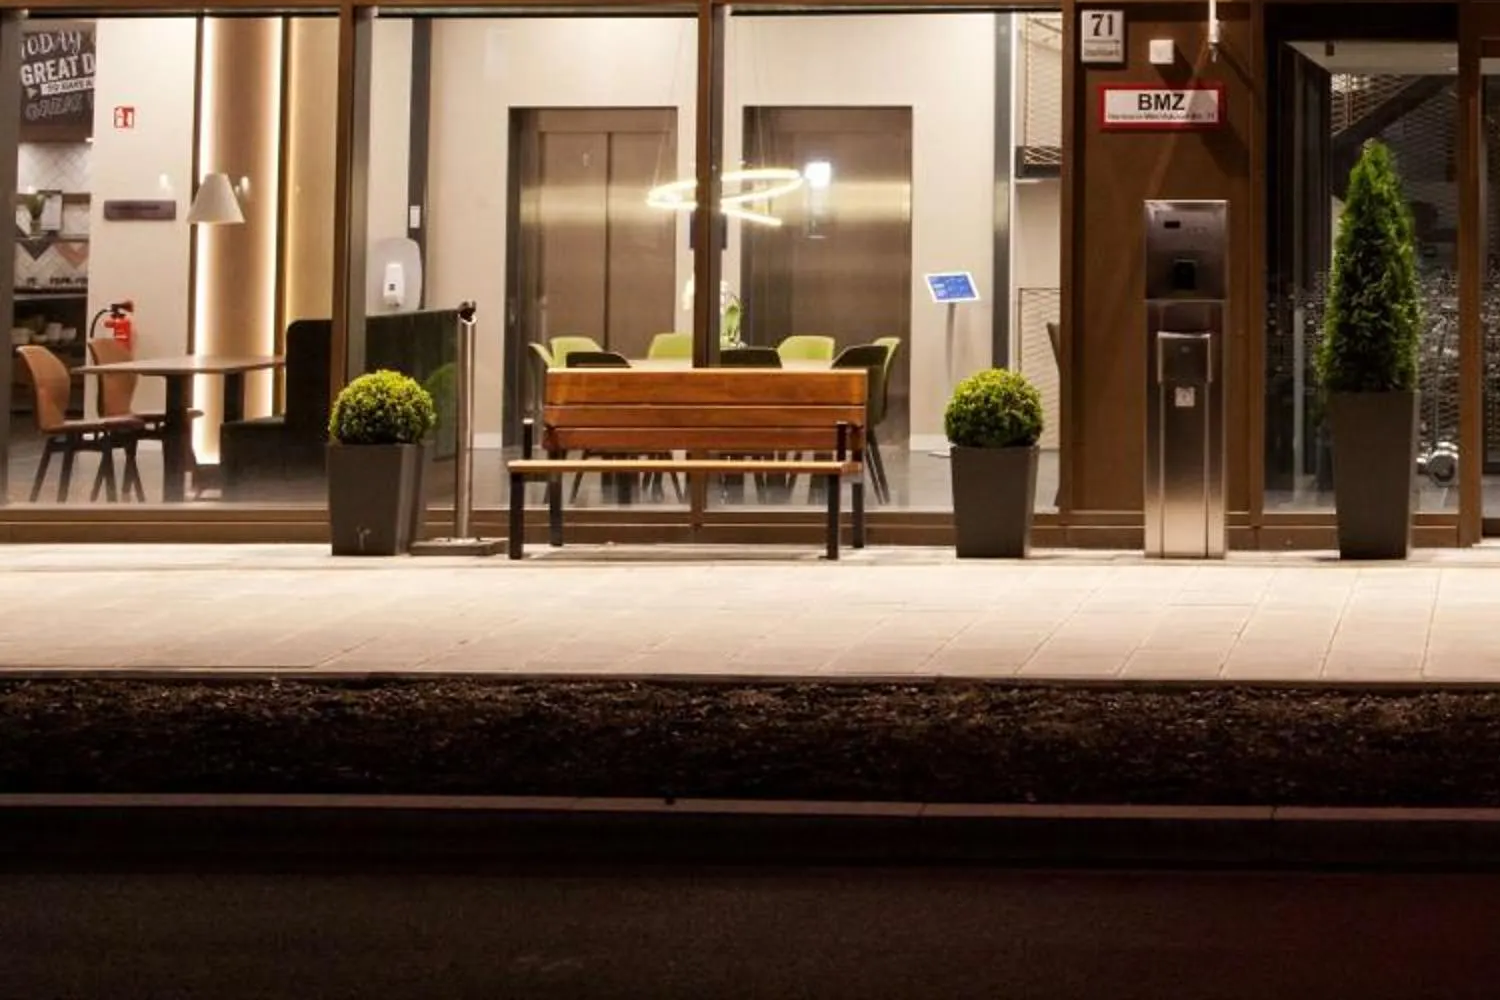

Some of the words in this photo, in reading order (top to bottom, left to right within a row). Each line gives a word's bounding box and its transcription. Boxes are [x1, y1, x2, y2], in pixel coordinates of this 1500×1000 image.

[1091, 13, 1114, 36] 71
[21, 55, 78, 86] GREAT
[1137, 93, 1185, 111] BMZ
